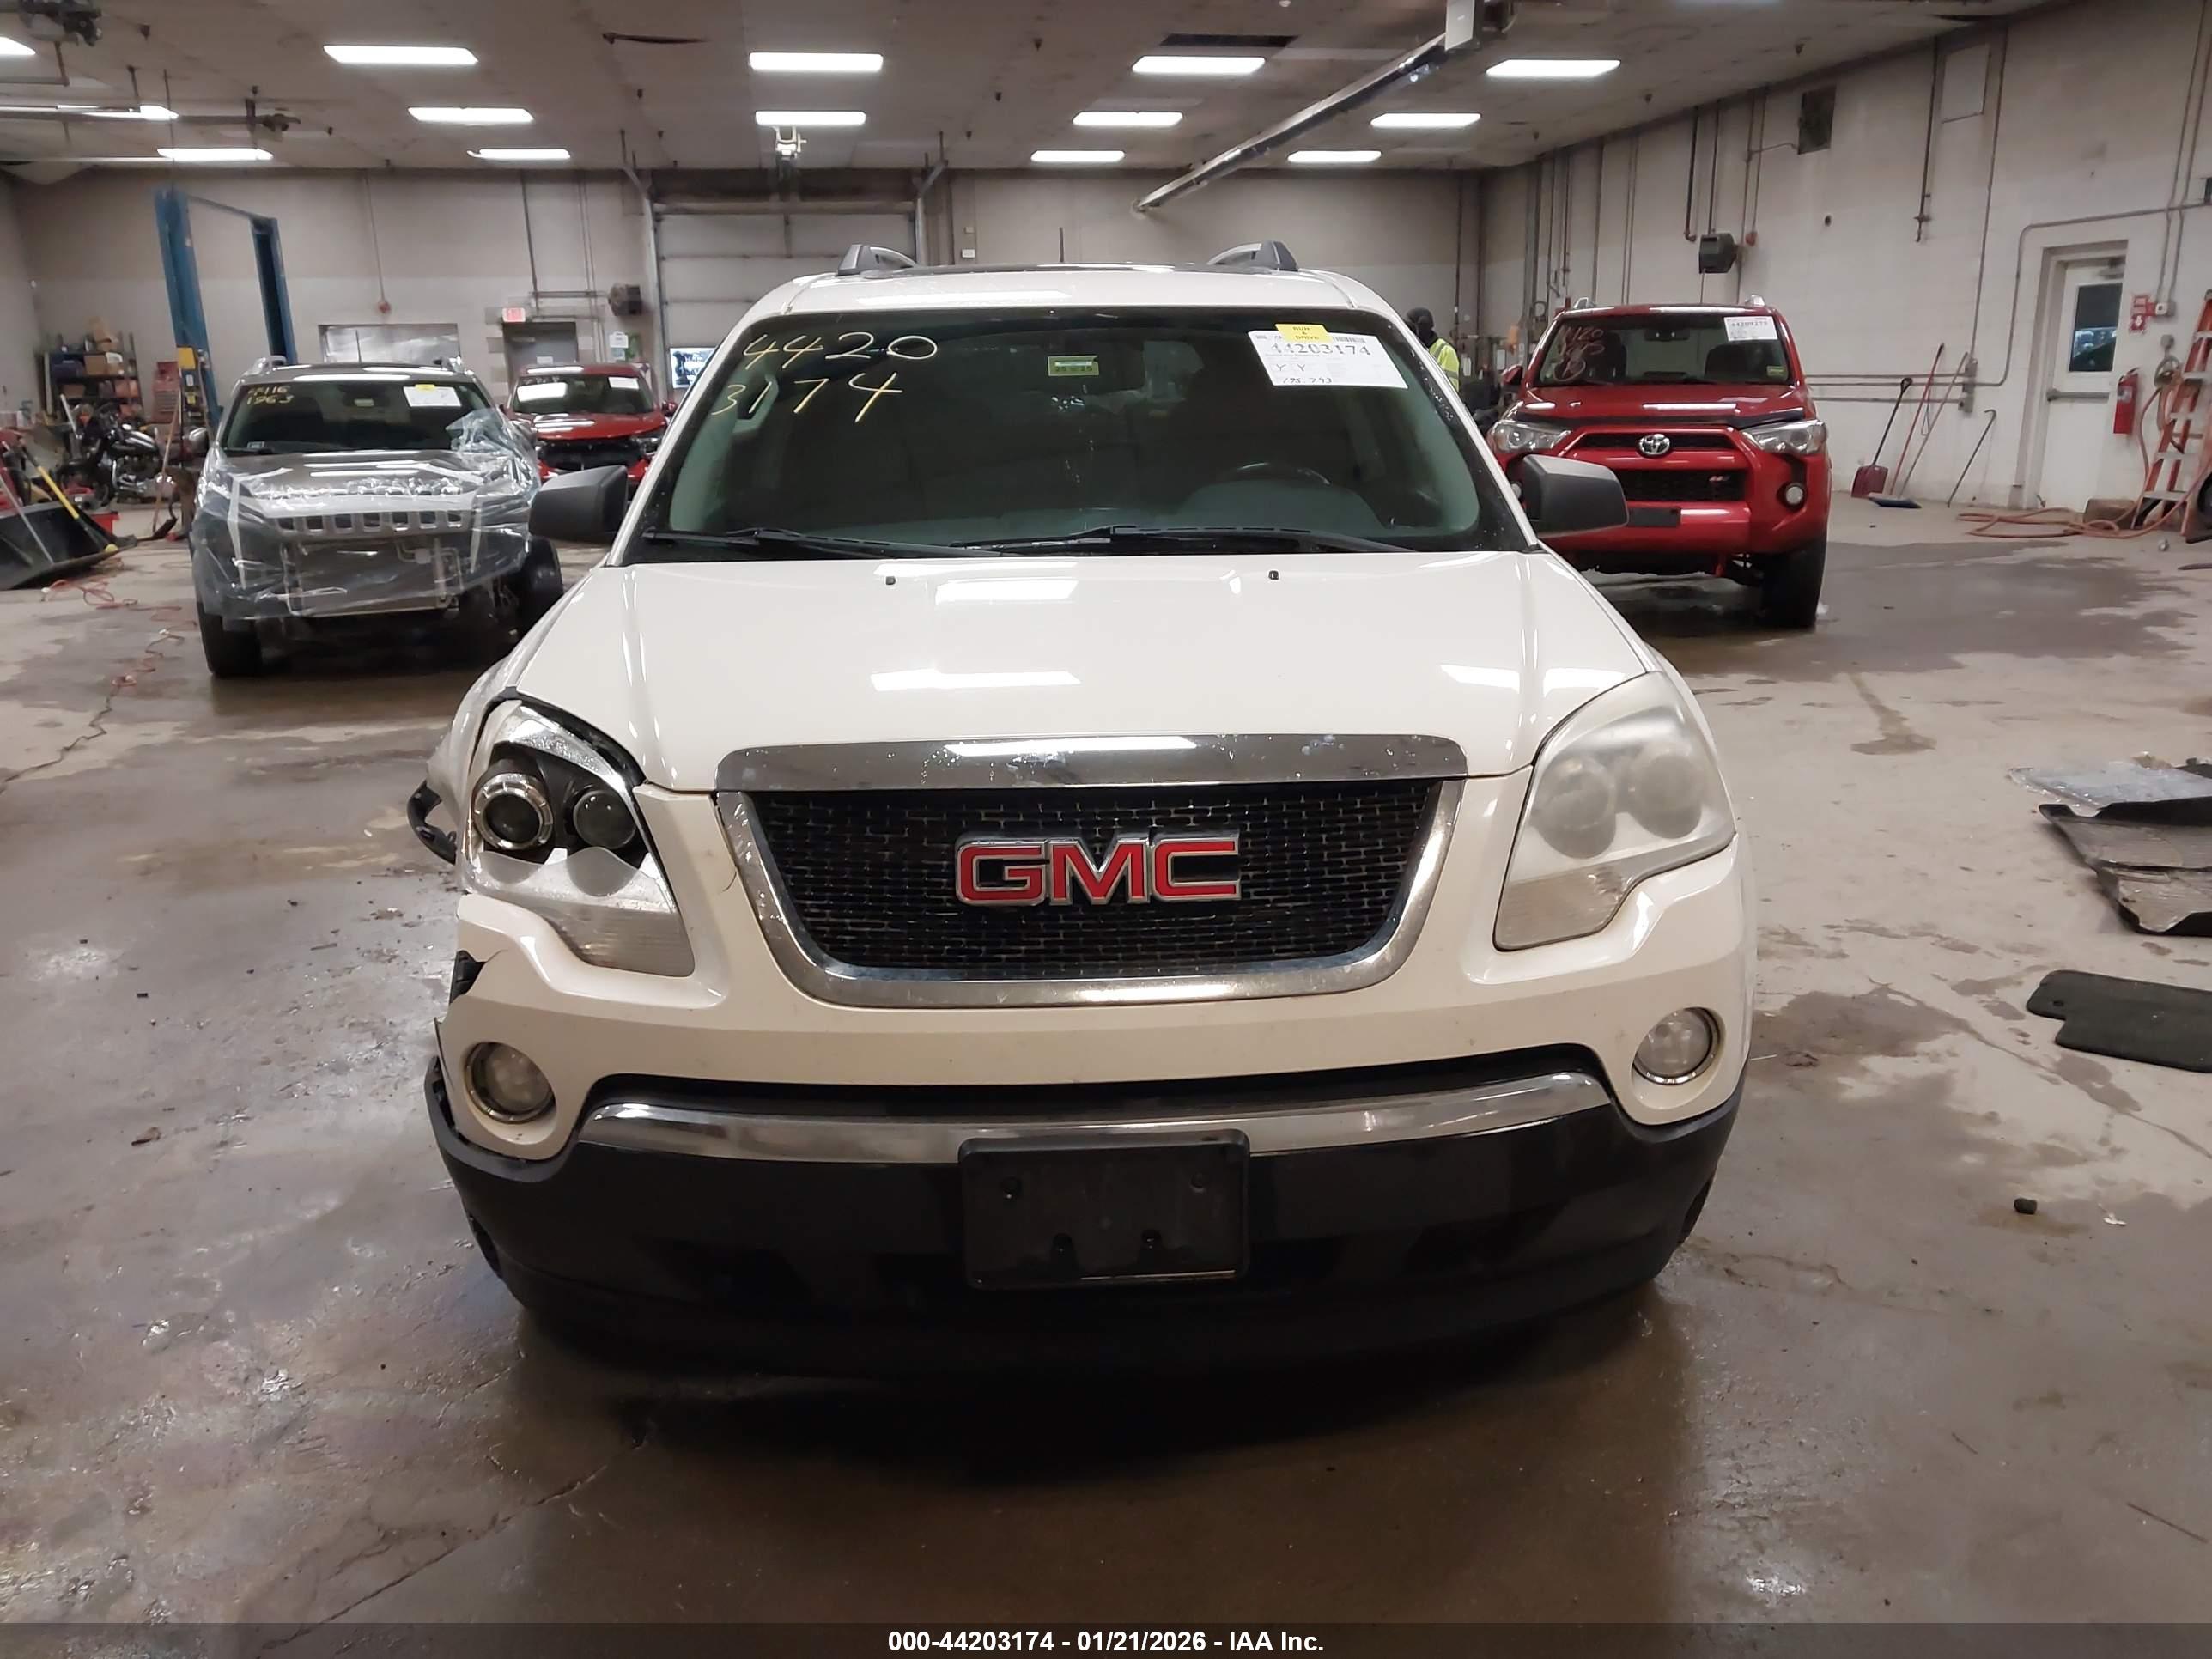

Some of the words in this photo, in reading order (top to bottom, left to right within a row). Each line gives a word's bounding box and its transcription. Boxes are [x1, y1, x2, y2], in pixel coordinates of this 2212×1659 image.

[743, 331, 939, 371] 4420
[1271, 343, 1372, 356] 44203174
[710, 371, 903, 423] 3174
[955, 836, 1241, 905] GMC
